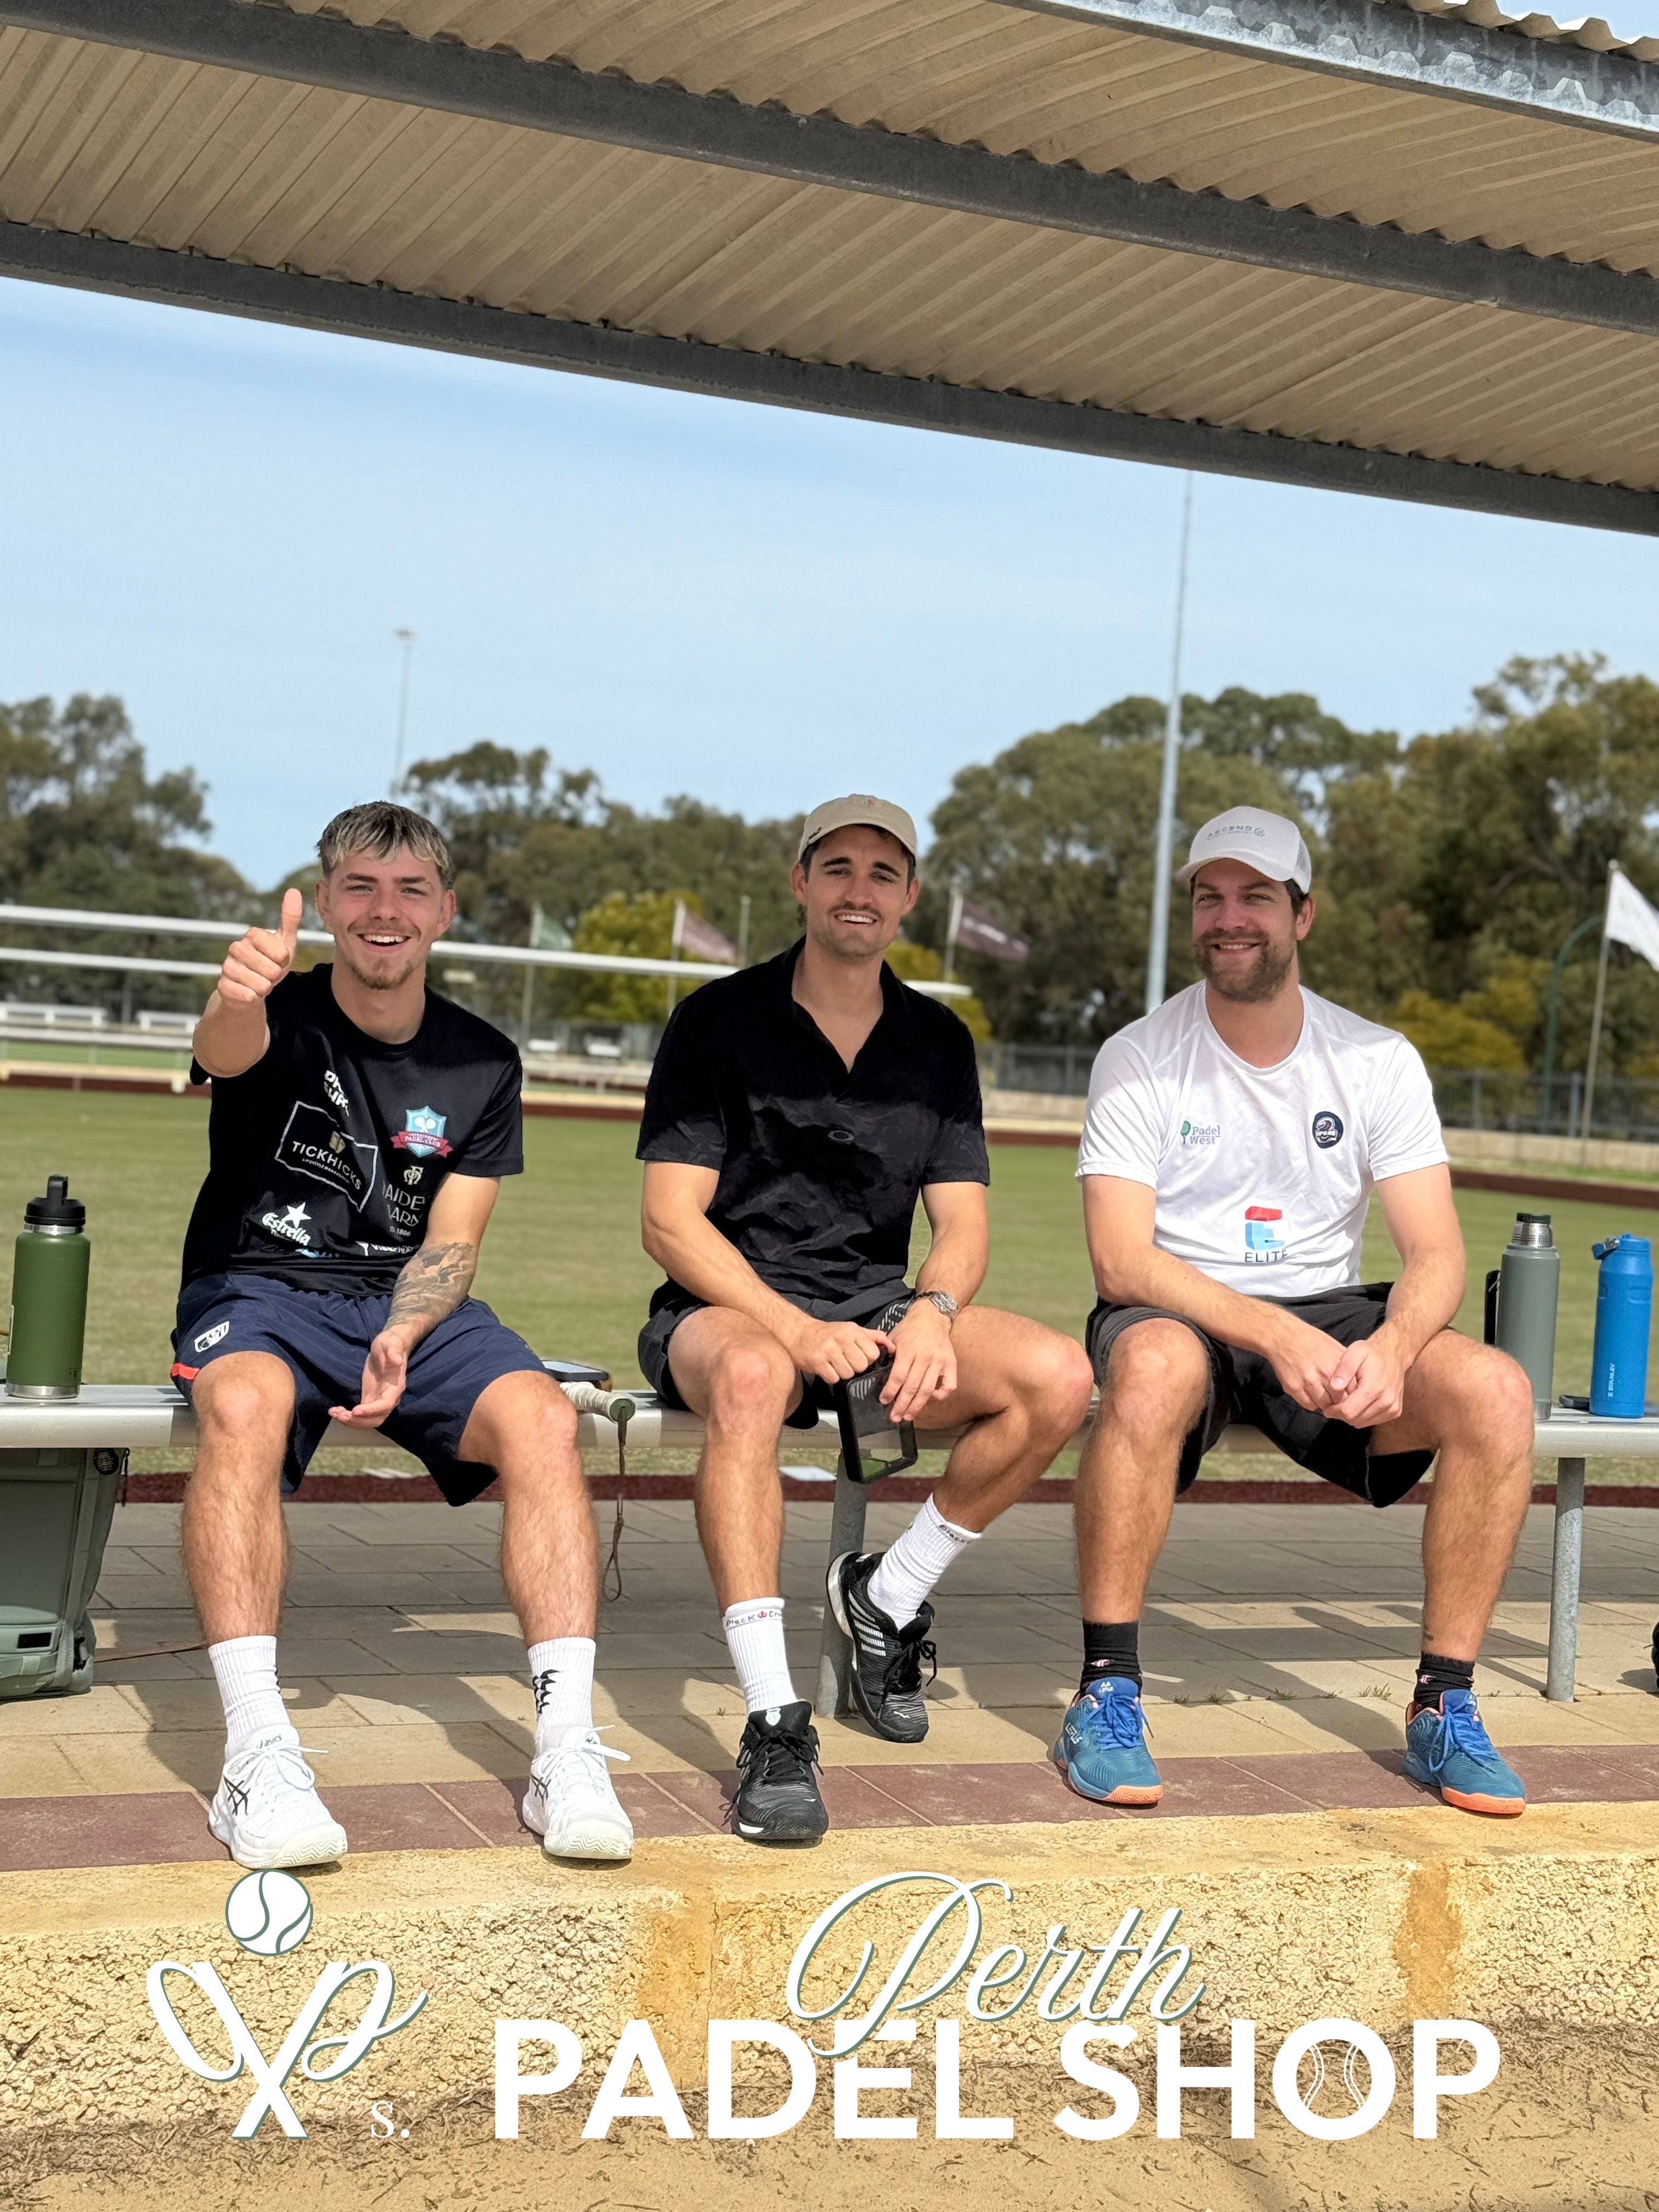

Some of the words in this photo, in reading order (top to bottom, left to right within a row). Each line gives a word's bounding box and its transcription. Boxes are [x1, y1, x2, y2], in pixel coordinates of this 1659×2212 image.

[1192, 1125, 1221, 1135] Padel
[1189, 1135, 1216, 1144] West
[292, 1141, 362, 1190] TICKHICKS
[262, 1212, 311, 1246] Estrella
[1245, 1249, 1288, 1262] ELITE
